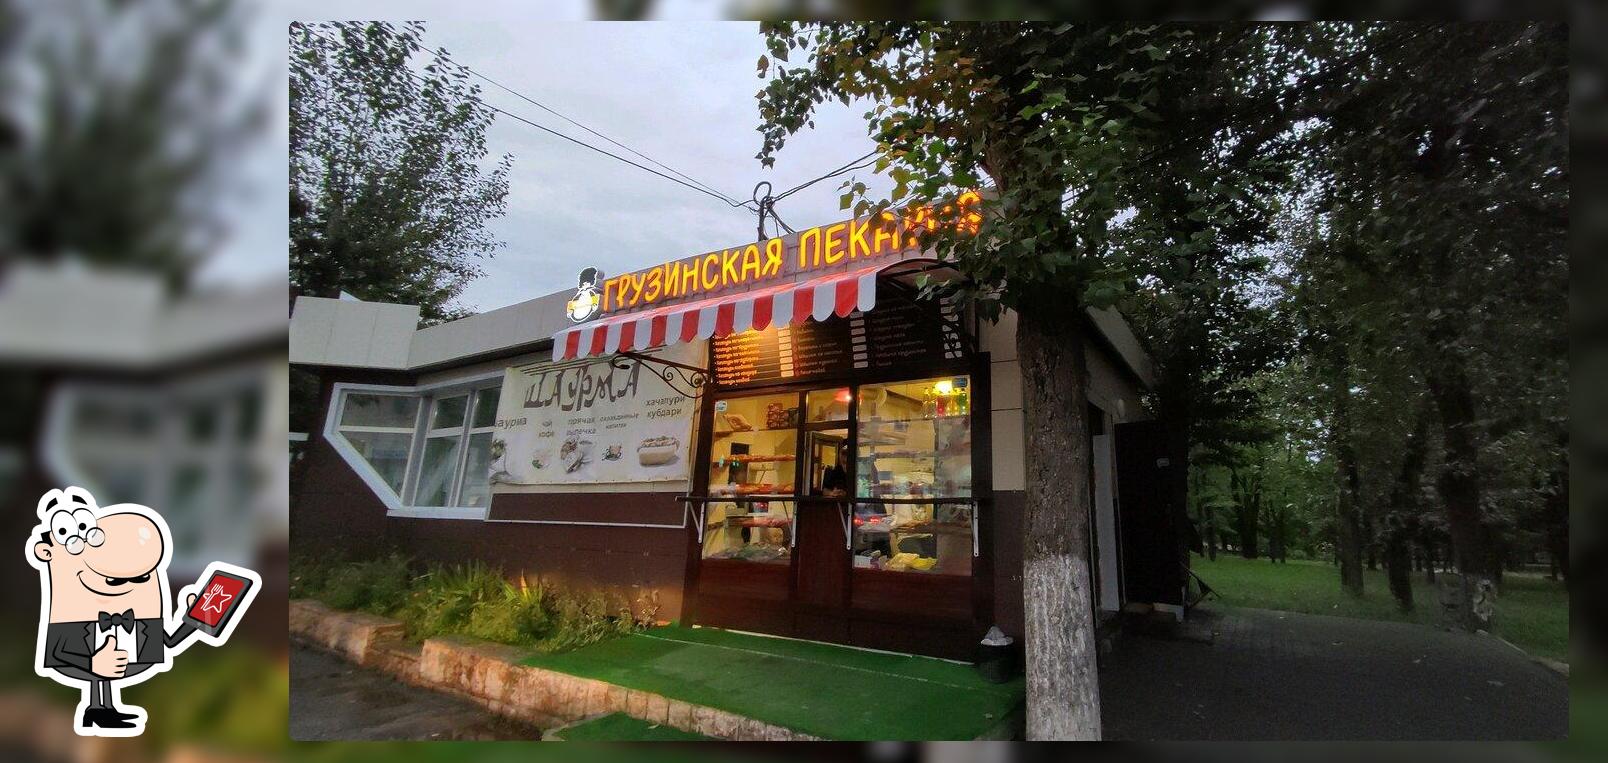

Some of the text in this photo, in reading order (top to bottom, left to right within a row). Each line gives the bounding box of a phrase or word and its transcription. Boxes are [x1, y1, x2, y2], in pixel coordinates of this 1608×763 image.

[603, 237, 784, 313] ГРУЗИНСКАЯ
[646, 394, 686, 407] хачапури
[647, 407, 683, 419] кубдари
[495, 416, 528, 430] аурма
